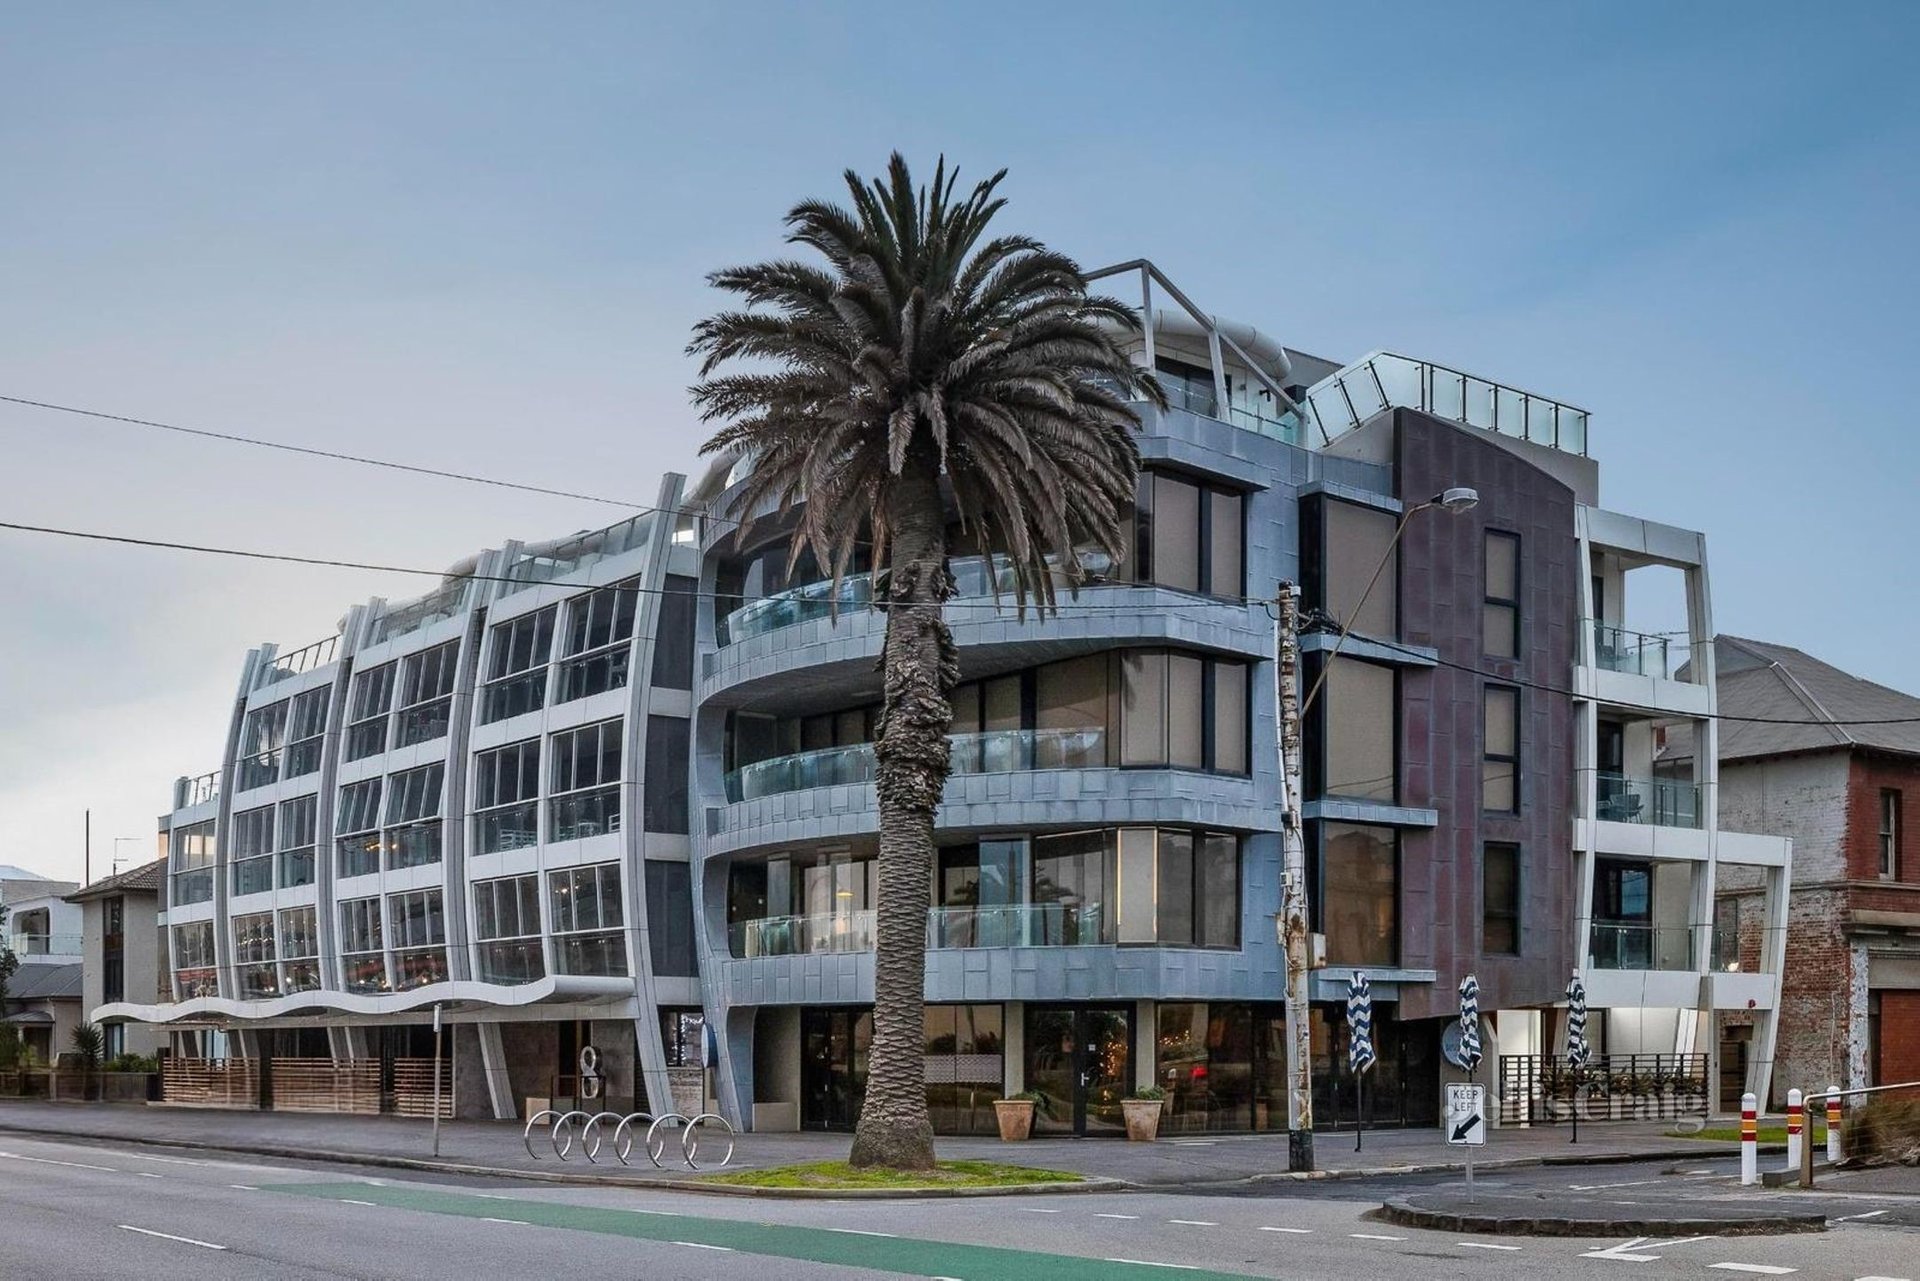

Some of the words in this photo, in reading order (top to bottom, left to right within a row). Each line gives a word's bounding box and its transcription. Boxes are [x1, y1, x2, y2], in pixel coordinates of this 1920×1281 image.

[580, 1046, 600, 1098] 8
[1453, 1089, 1479, 1100] KEEP
[1454, 1101, 1478, 1112] LEFT
